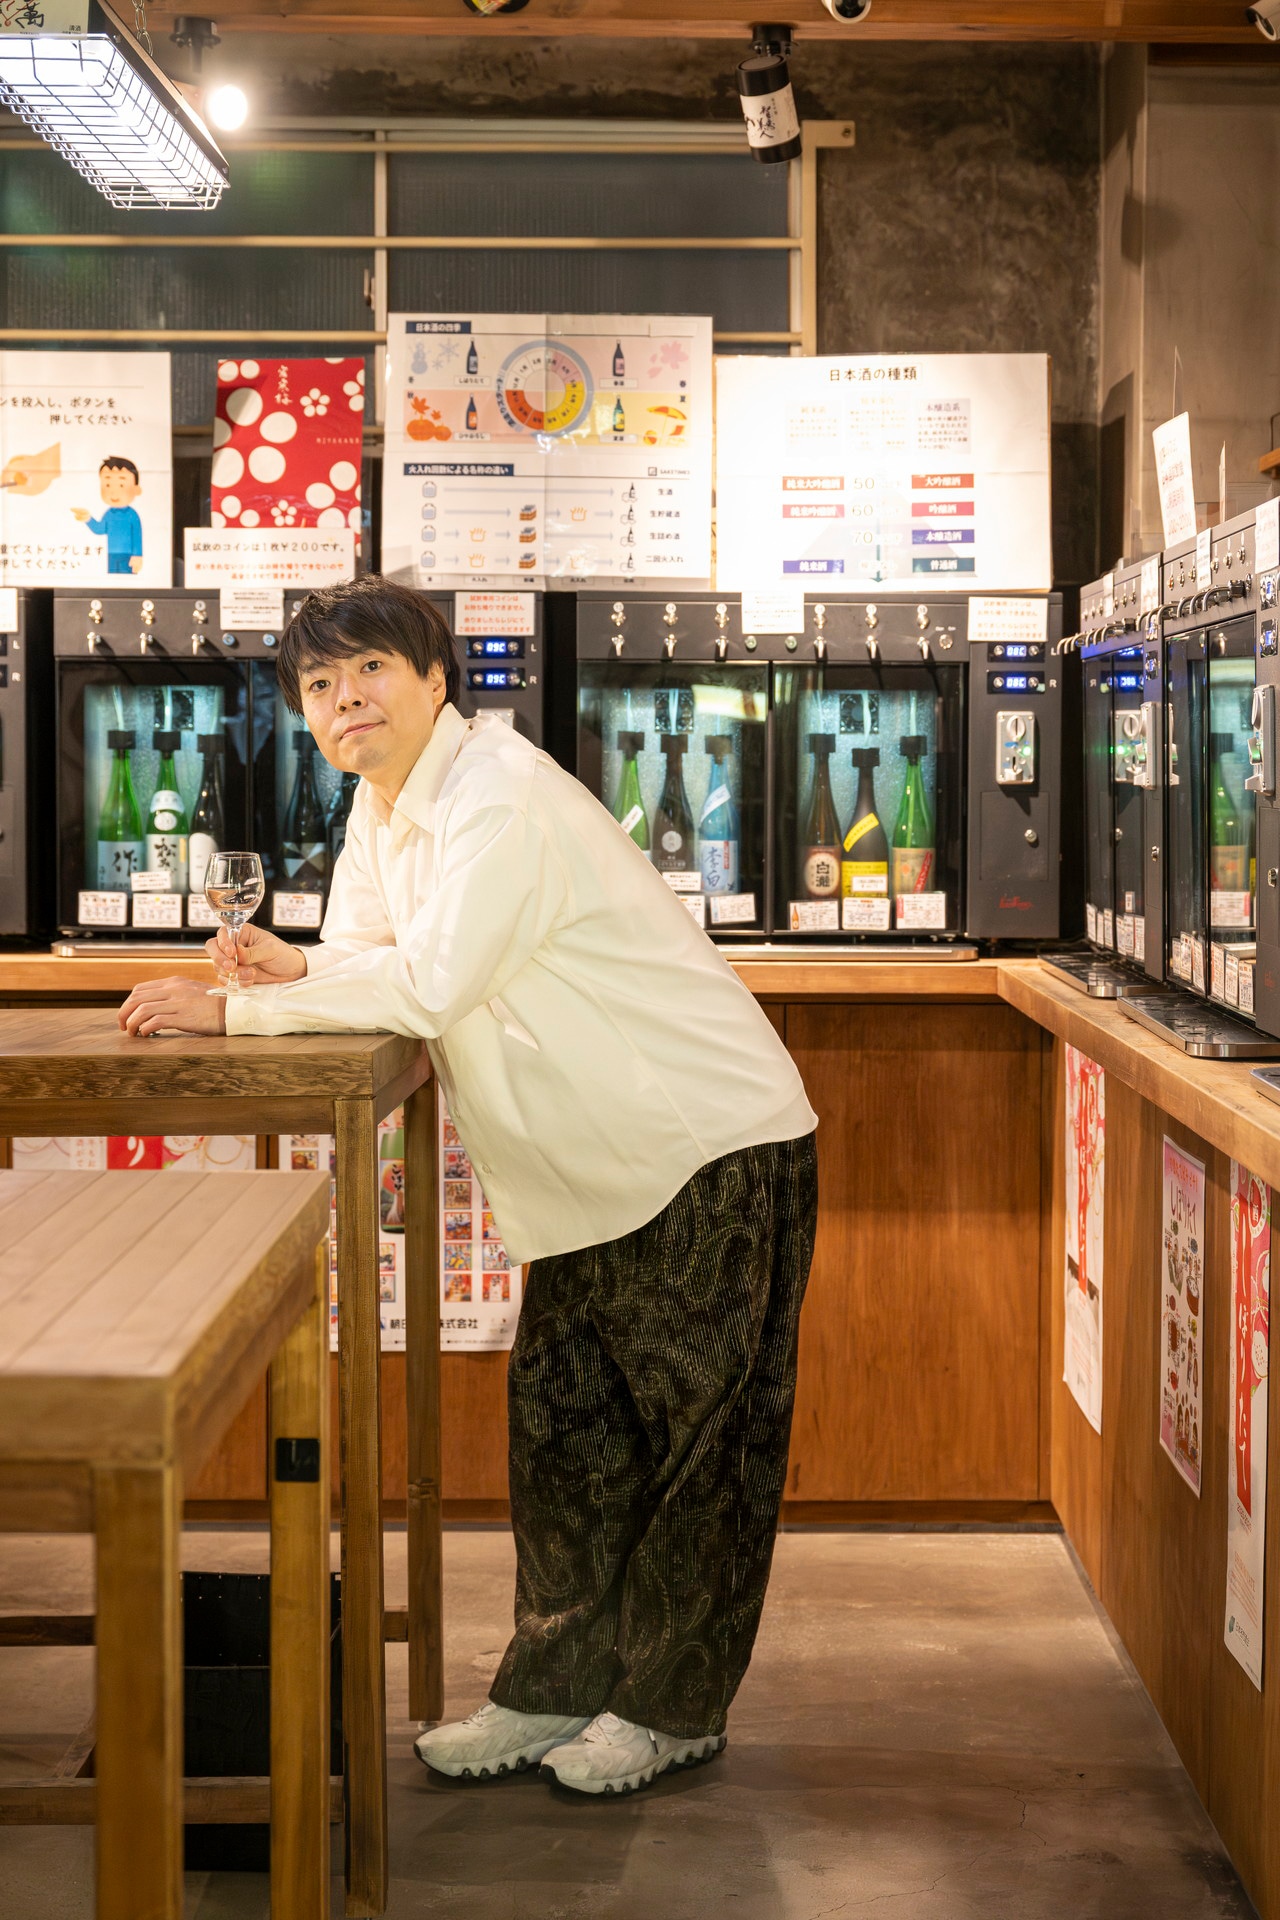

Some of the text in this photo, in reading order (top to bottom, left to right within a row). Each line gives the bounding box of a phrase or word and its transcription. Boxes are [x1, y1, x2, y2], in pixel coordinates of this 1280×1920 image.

[415, 322, 462, 333] 日本酒の四季
[829, 365, 918, 382] 日本酒の種類
[49, 414, 133, 425] 押してください
[657, 488, 673, 496] 生酒
[645, 555, 684, 563] 二回火入れ
[12, 639, 21, 650] L
[530, 643, 537, 652] L
[1050, 647, 1057, 656] L
[12, 671, 21, 682] R
[529, 675, 538, 684] R
[1049, 679, 1057, 688] R
[111, 849, 138, 877] 作
[704, 846, 724, 887] 李白
[815, 861, 831, 888] 白瀧
[1238, 1212, 1249, 1492] しぼりたて
